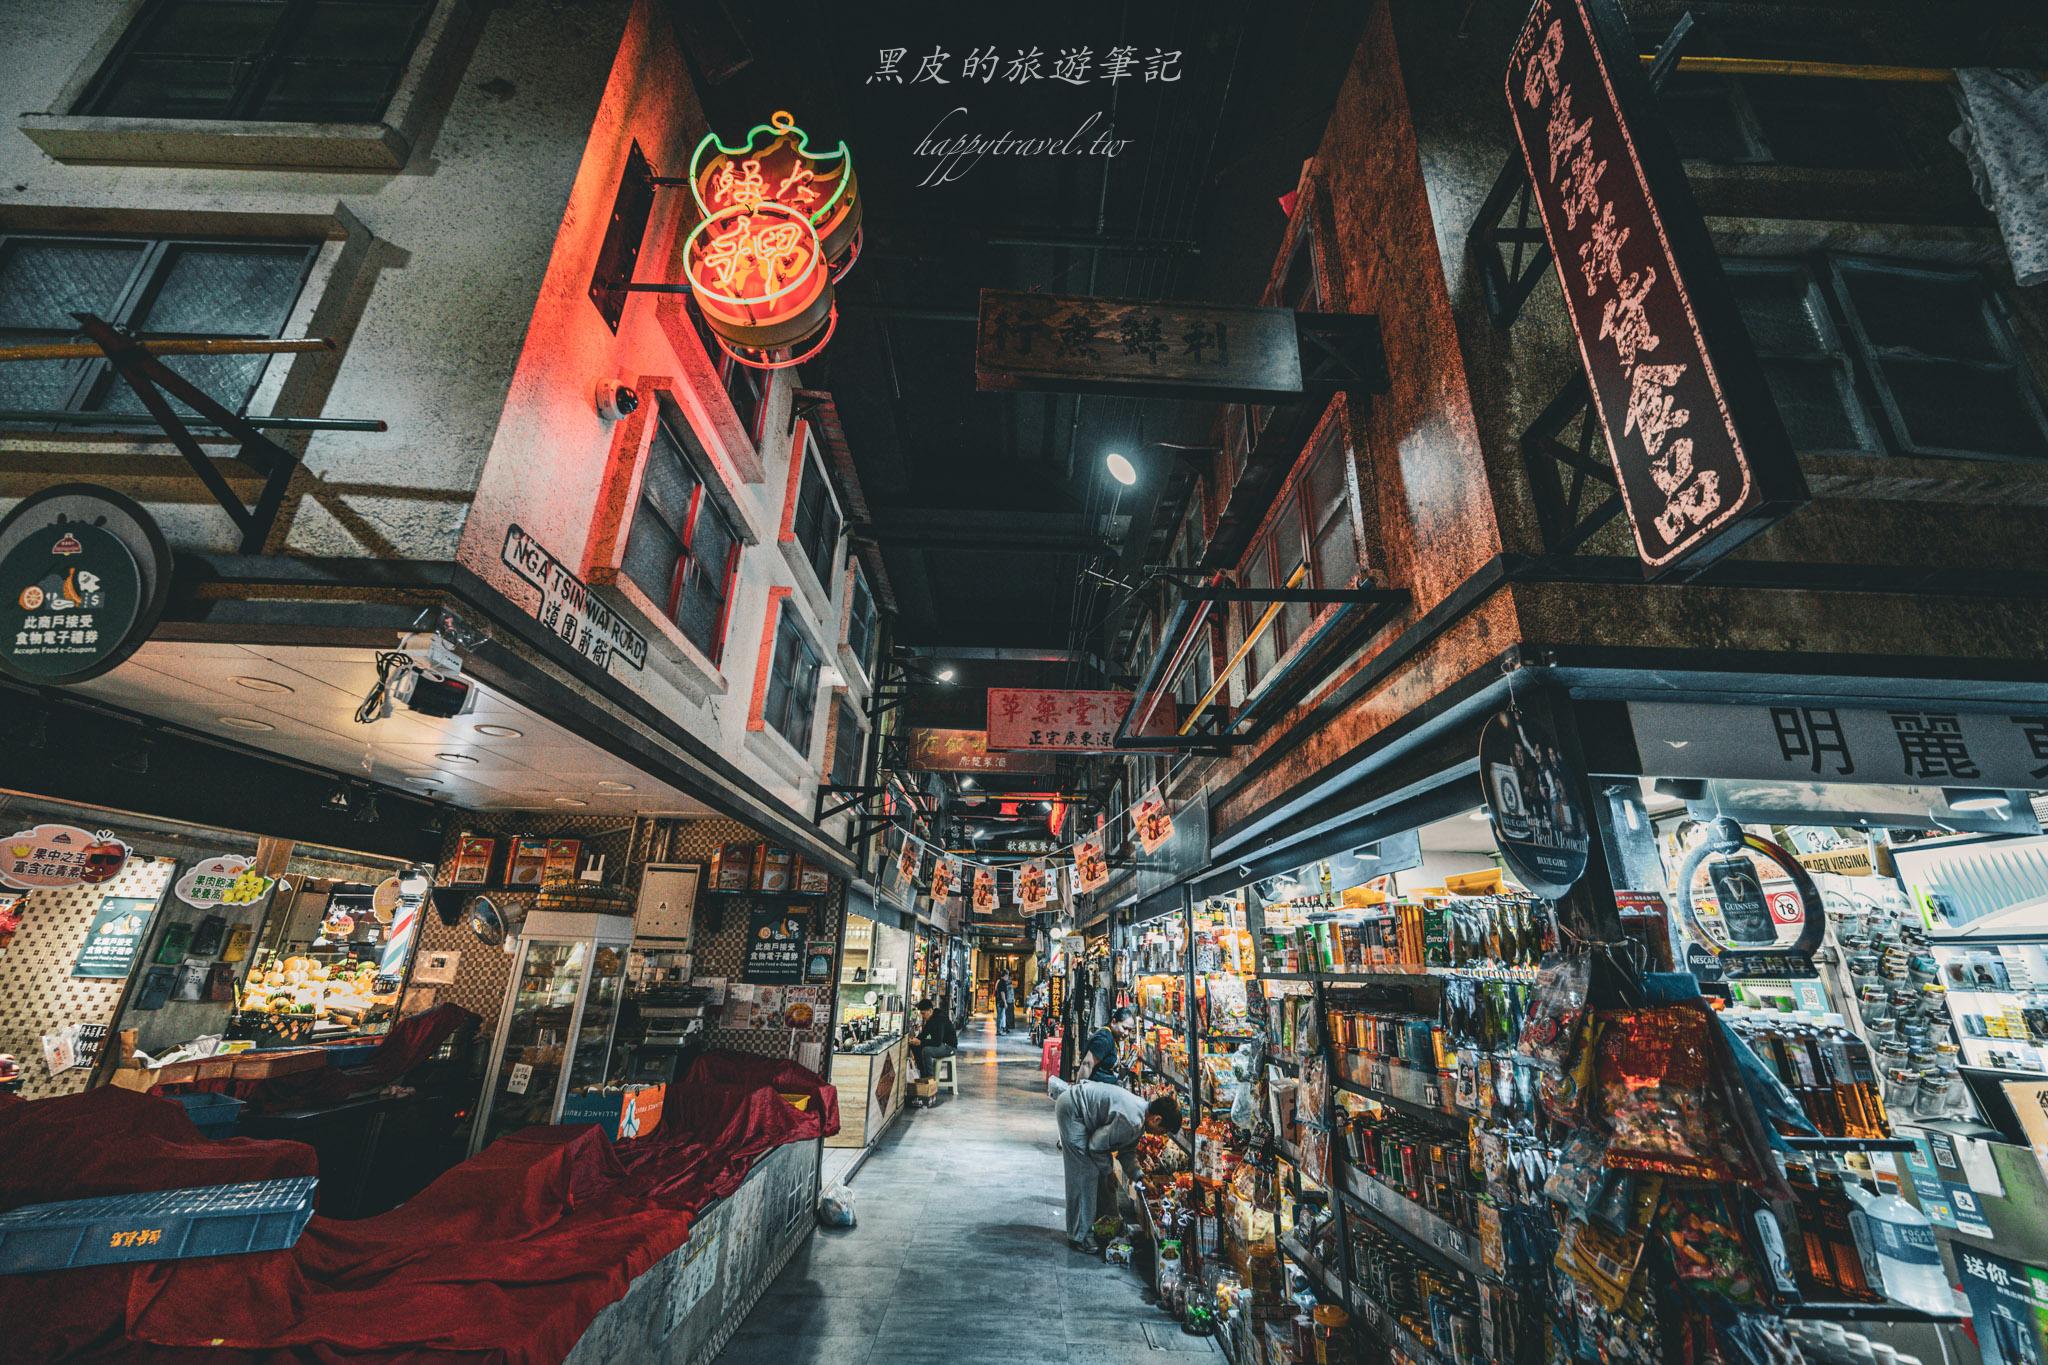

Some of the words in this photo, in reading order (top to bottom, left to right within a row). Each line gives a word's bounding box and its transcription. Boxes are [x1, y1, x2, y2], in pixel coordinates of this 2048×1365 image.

[513, 541, 548, 585] NGA
[551, 569, 585, 612] TSIN
[586, 602, 608, 634] WAI
[611, 623, 643, 658] ROAD
[23, 614, 94, 630] 此商戶接受
[15, 630, 98, 645] 食物電子禮券
[13, 646, 40, 655] Accepts
[41, 646, 59, 654] Food
[59, 646, 97, 654] e-Coupons
[33, 847, 88, 865] 果中之王
[1832, 853, 1871, 871] VIRGINIA
[12, 860, 82, 878] 富含花青素
[1724, 901, 1759, 911] GUINNESS
[755, 943, 796, 951] 此商戶接受
[584, 1110, 619, 1118] ALLIANCE
